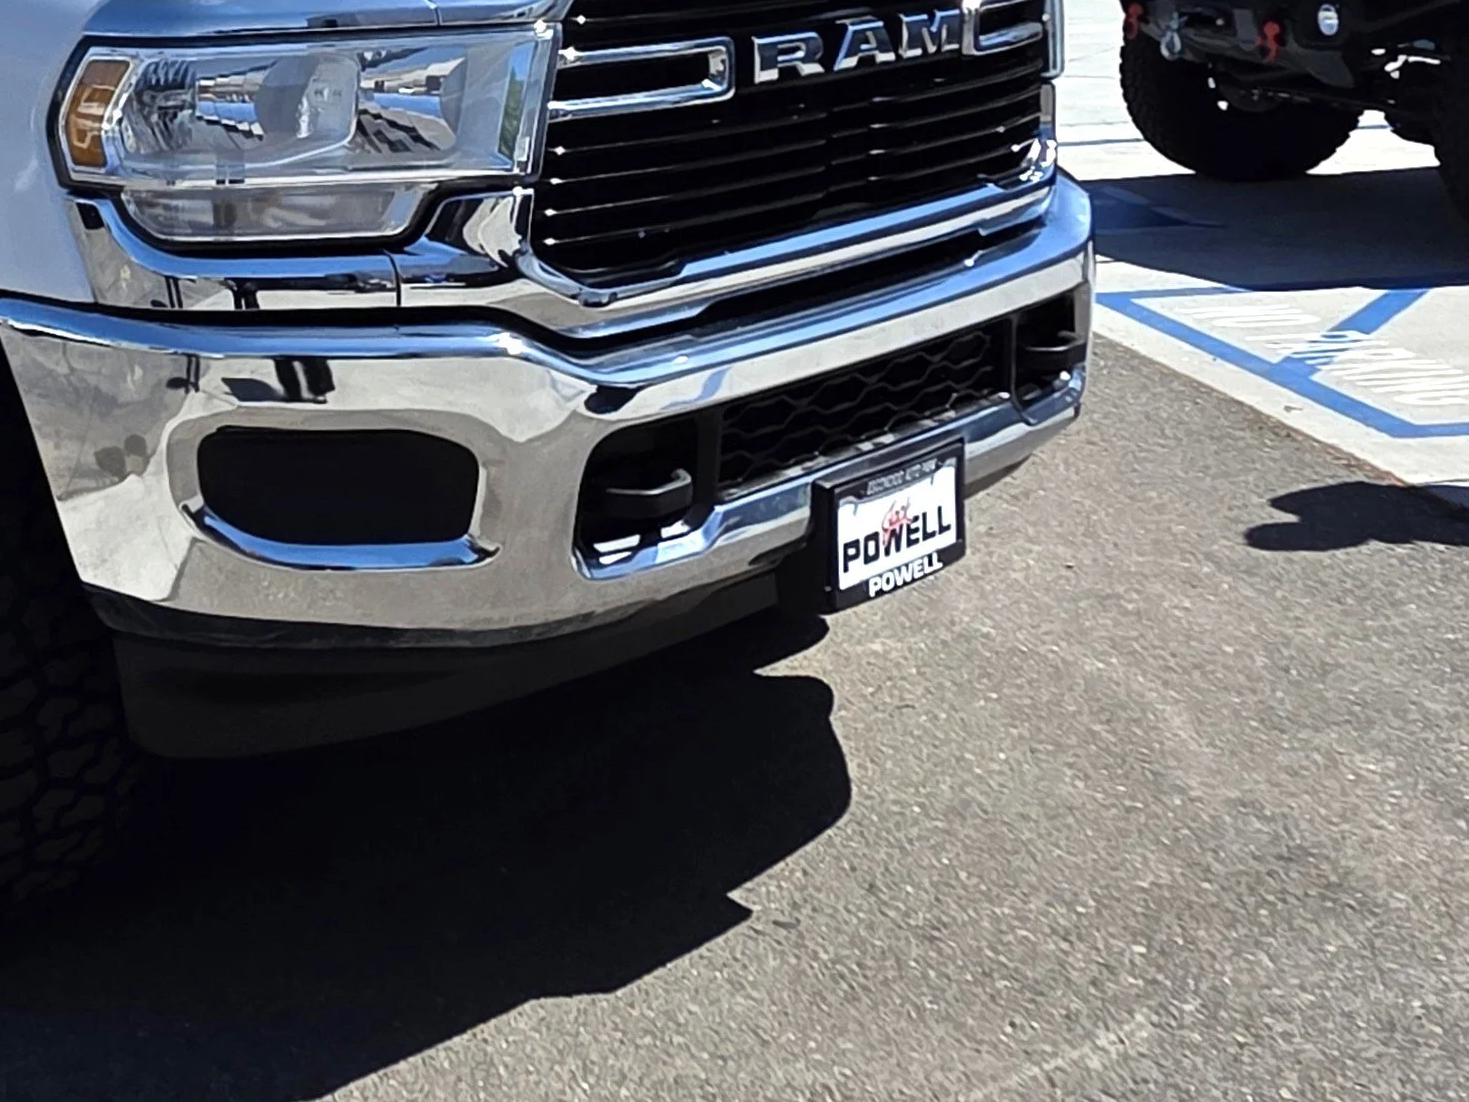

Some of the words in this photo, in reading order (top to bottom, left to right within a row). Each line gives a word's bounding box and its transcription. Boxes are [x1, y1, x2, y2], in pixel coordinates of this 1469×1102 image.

[750, 8, 961, 84] RAM
[842, 505, 952, 574] POWELL
[868, 551, 944, 598] POWELL
